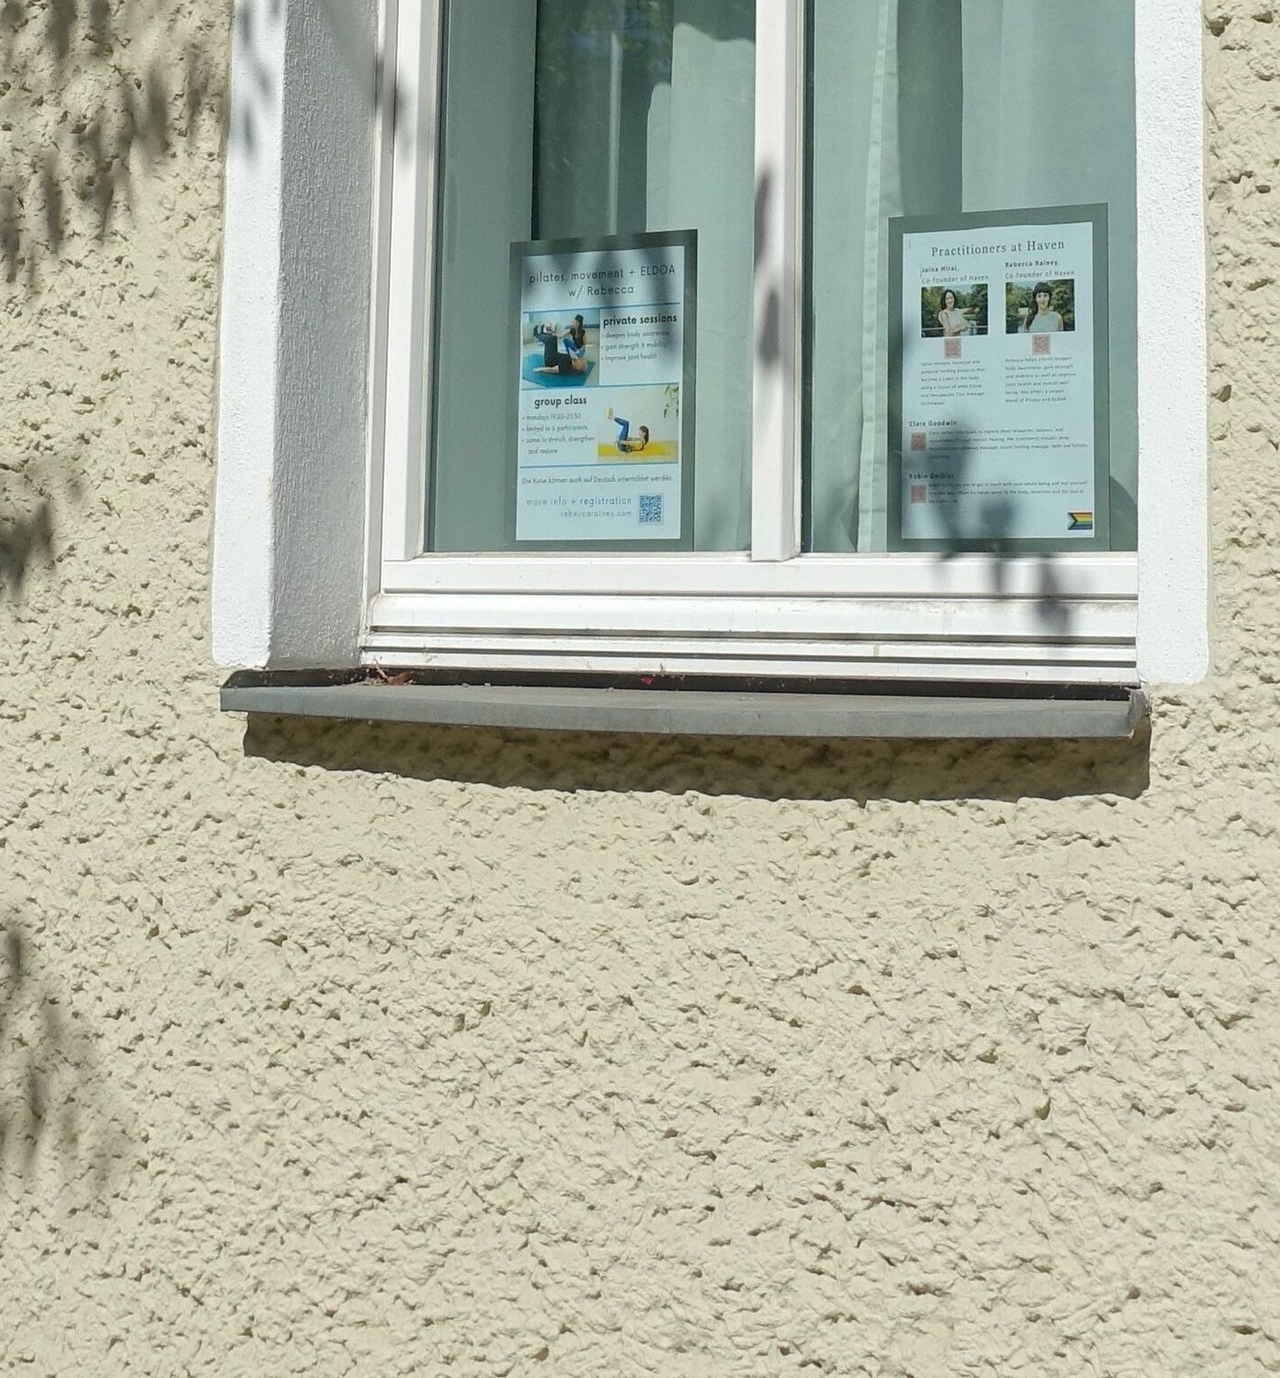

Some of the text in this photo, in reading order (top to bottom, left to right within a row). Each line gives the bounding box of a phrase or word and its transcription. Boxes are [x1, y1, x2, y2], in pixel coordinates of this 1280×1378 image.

[931, 239, 1065, 257] Practitioners at Haven
[528, 271, 568, 285] pilates,
[571, 268, 624, 281] movement
[568, 284, 635, 300] w/ Rebecca
[603, 312, 678, 329] private sessions
[534, 393, 588, 409] group class
[579, 495, 632, 508] registration
